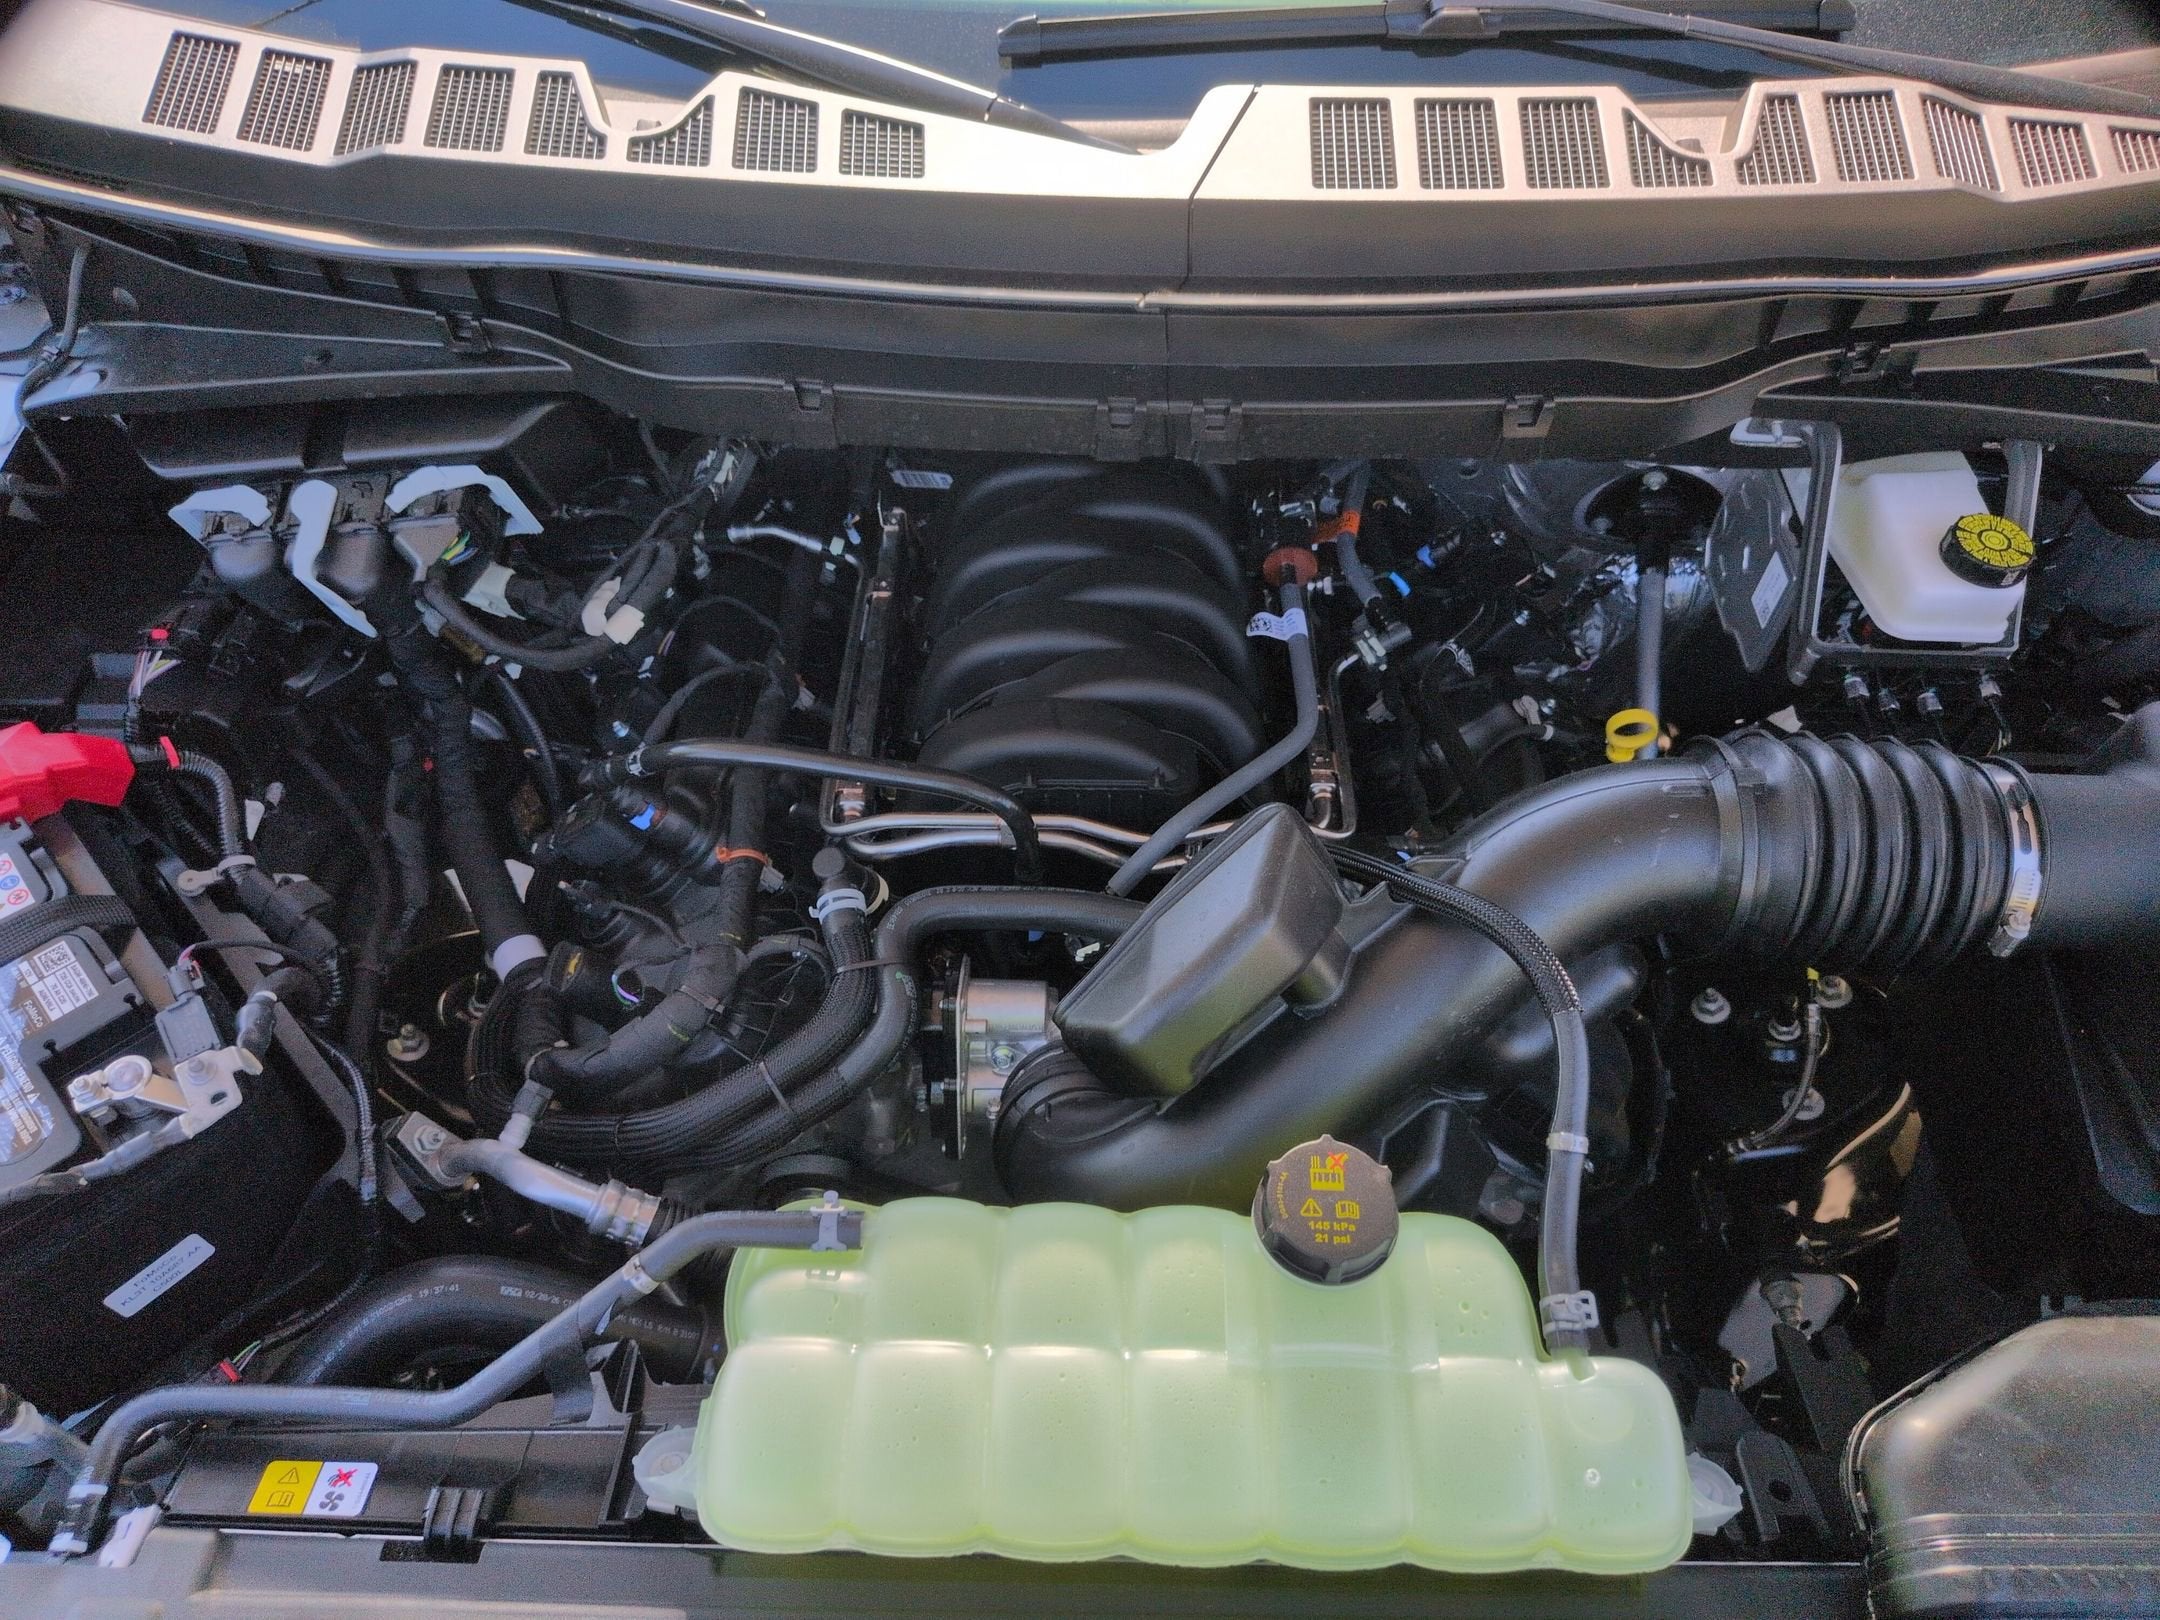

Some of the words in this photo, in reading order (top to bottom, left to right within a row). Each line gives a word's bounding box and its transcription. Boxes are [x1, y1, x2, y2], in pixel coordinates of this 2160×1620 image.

[24, 1000, 43, 1028] FoMoCo
[1308, 1220, 1330, 1231] 145
[1333, 1221, 1356, 1232] kPa
[1315, 1232, 1329, 1243] 21
[1333, 1234, 1351, 1245] psi
